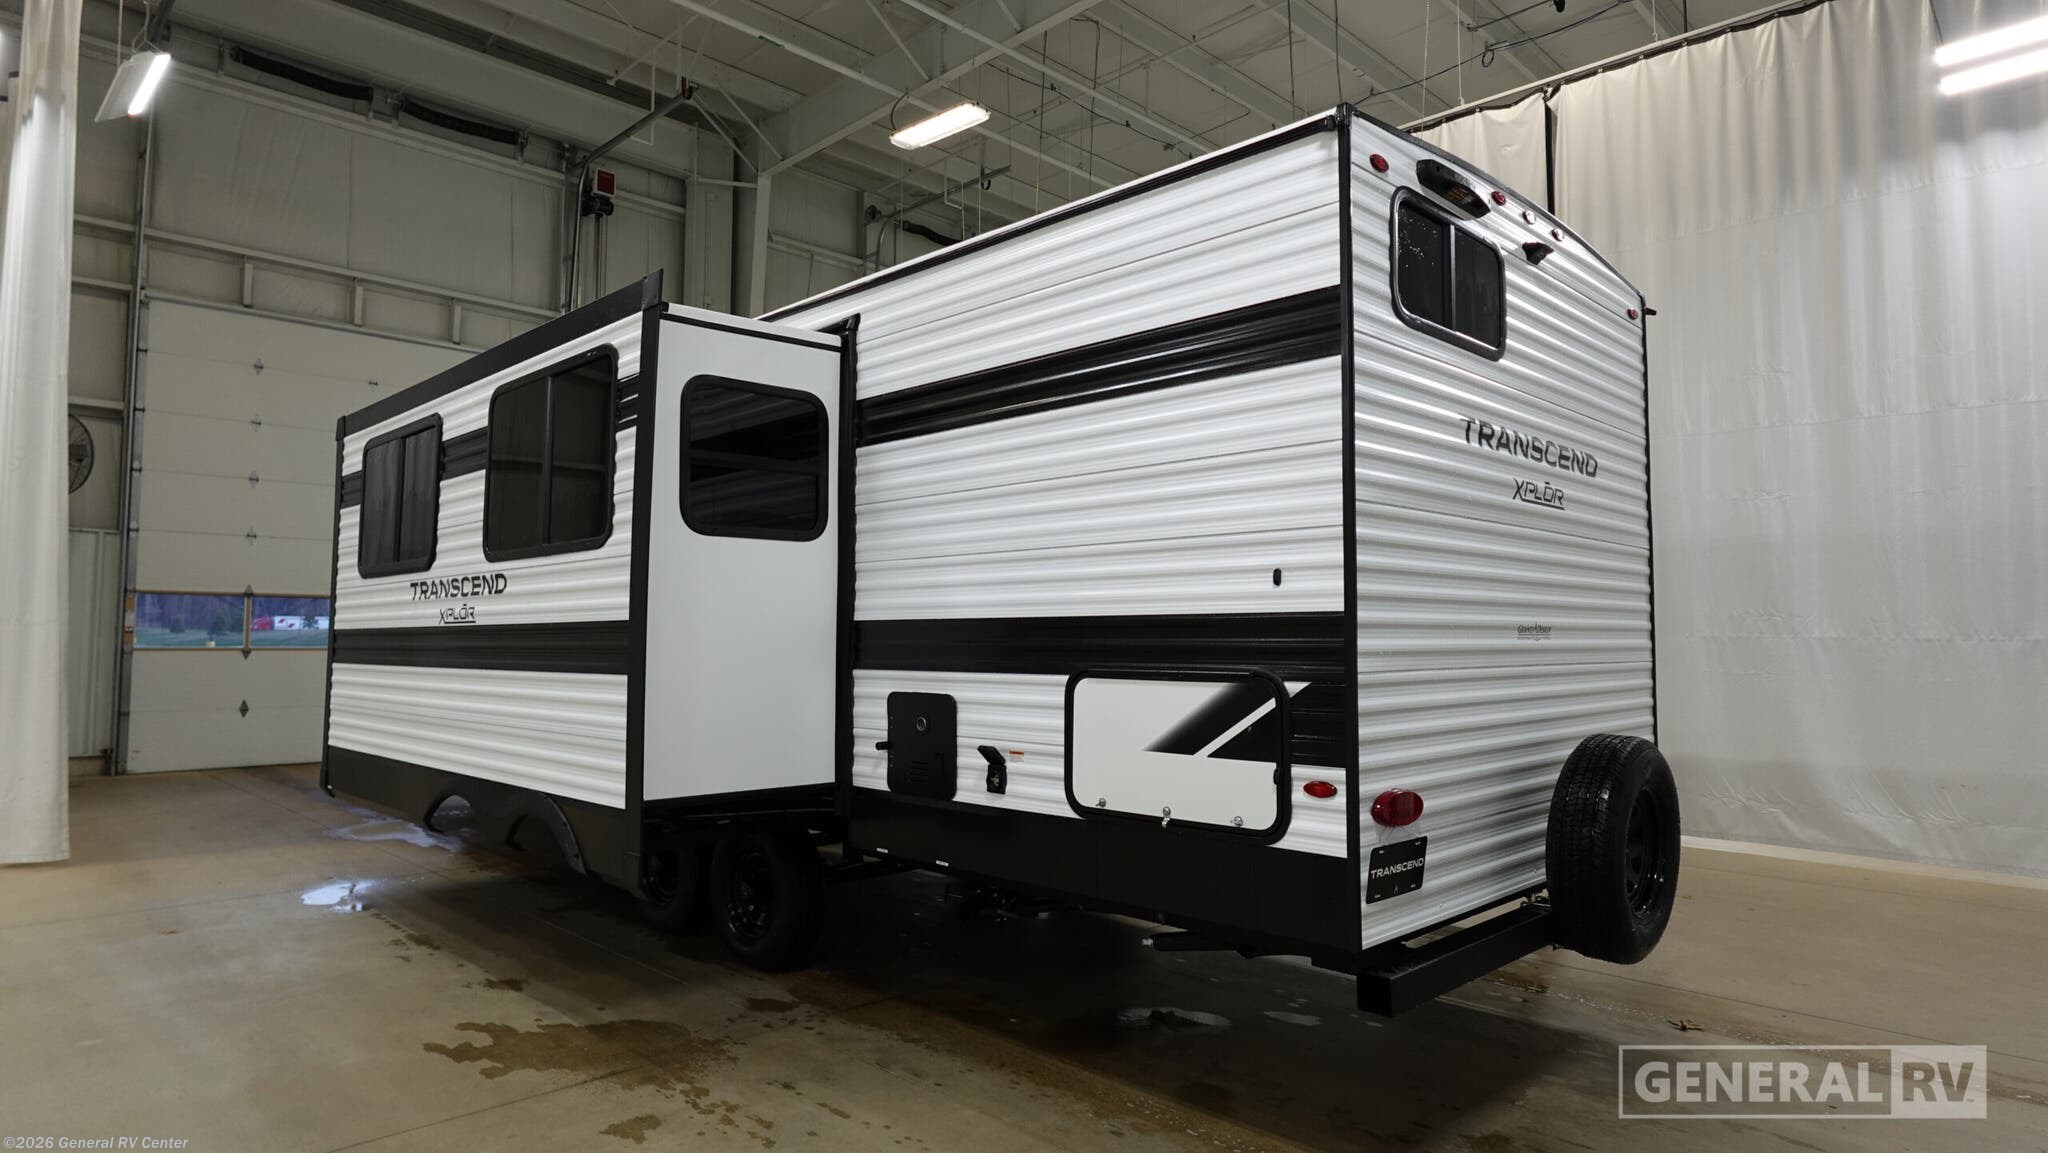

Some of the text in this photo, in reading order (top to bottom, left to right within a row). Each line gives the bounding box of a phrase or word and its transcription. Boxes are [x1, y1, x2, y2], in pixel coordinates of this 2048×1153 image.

[1459, 416, 1599, 478] TRANSCEND
[410, 573, 507, 600] TRANSCEND
[1370, 858, 1424, 879] TRANSCEND
